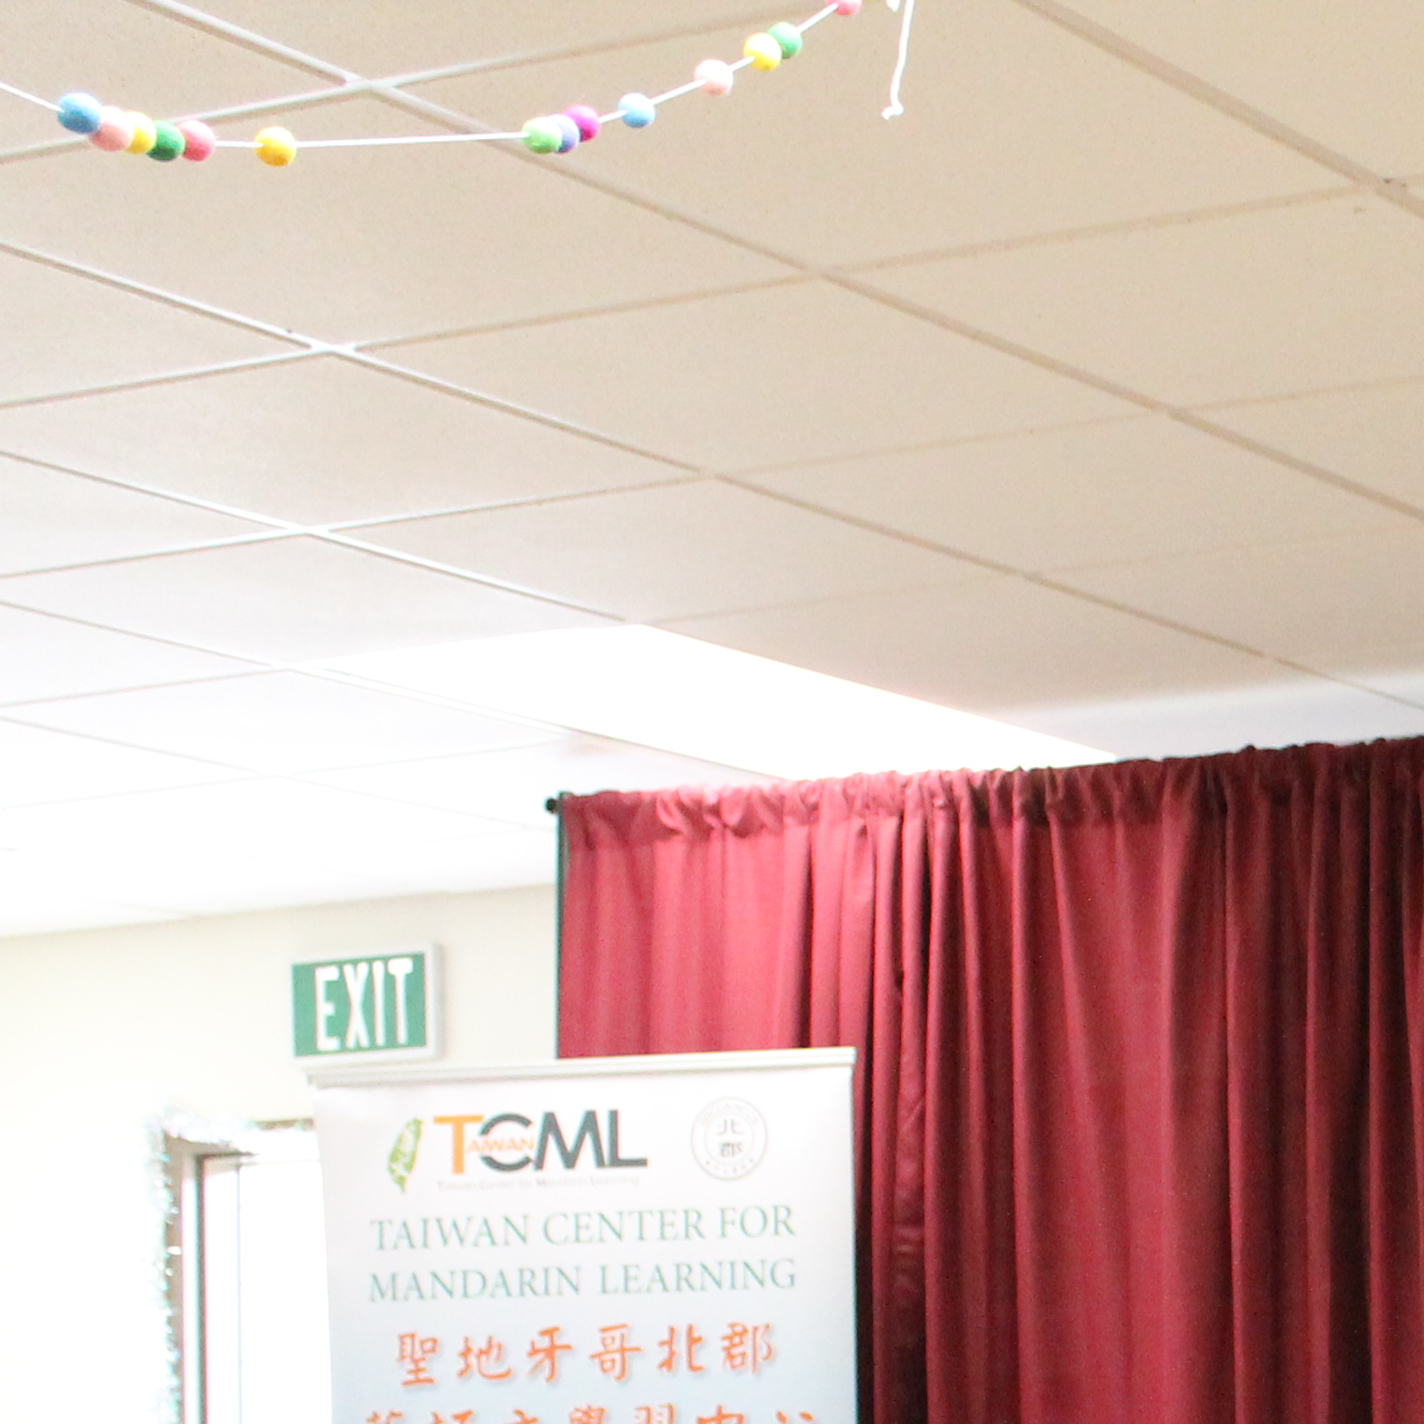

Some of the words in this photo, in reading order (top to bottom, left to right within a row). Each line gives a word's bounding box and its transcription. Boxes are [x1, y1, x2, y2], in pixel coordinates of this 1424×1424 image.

[314, 957, 414, 1051] EXIT
[433, 1109, 648, 1175] TCML
[370, 1214, 529, 1251] TAIWAN
[542, 1207, 705, 1243] CENTER
[718, 1205, 797, 1239] FOR
[369, 1265, 581, 1302] MANDARIN
[599, 1258, 796, 1294] LEARNING
[396, 1322, 773, 1387] 聖地牙哥北郡
